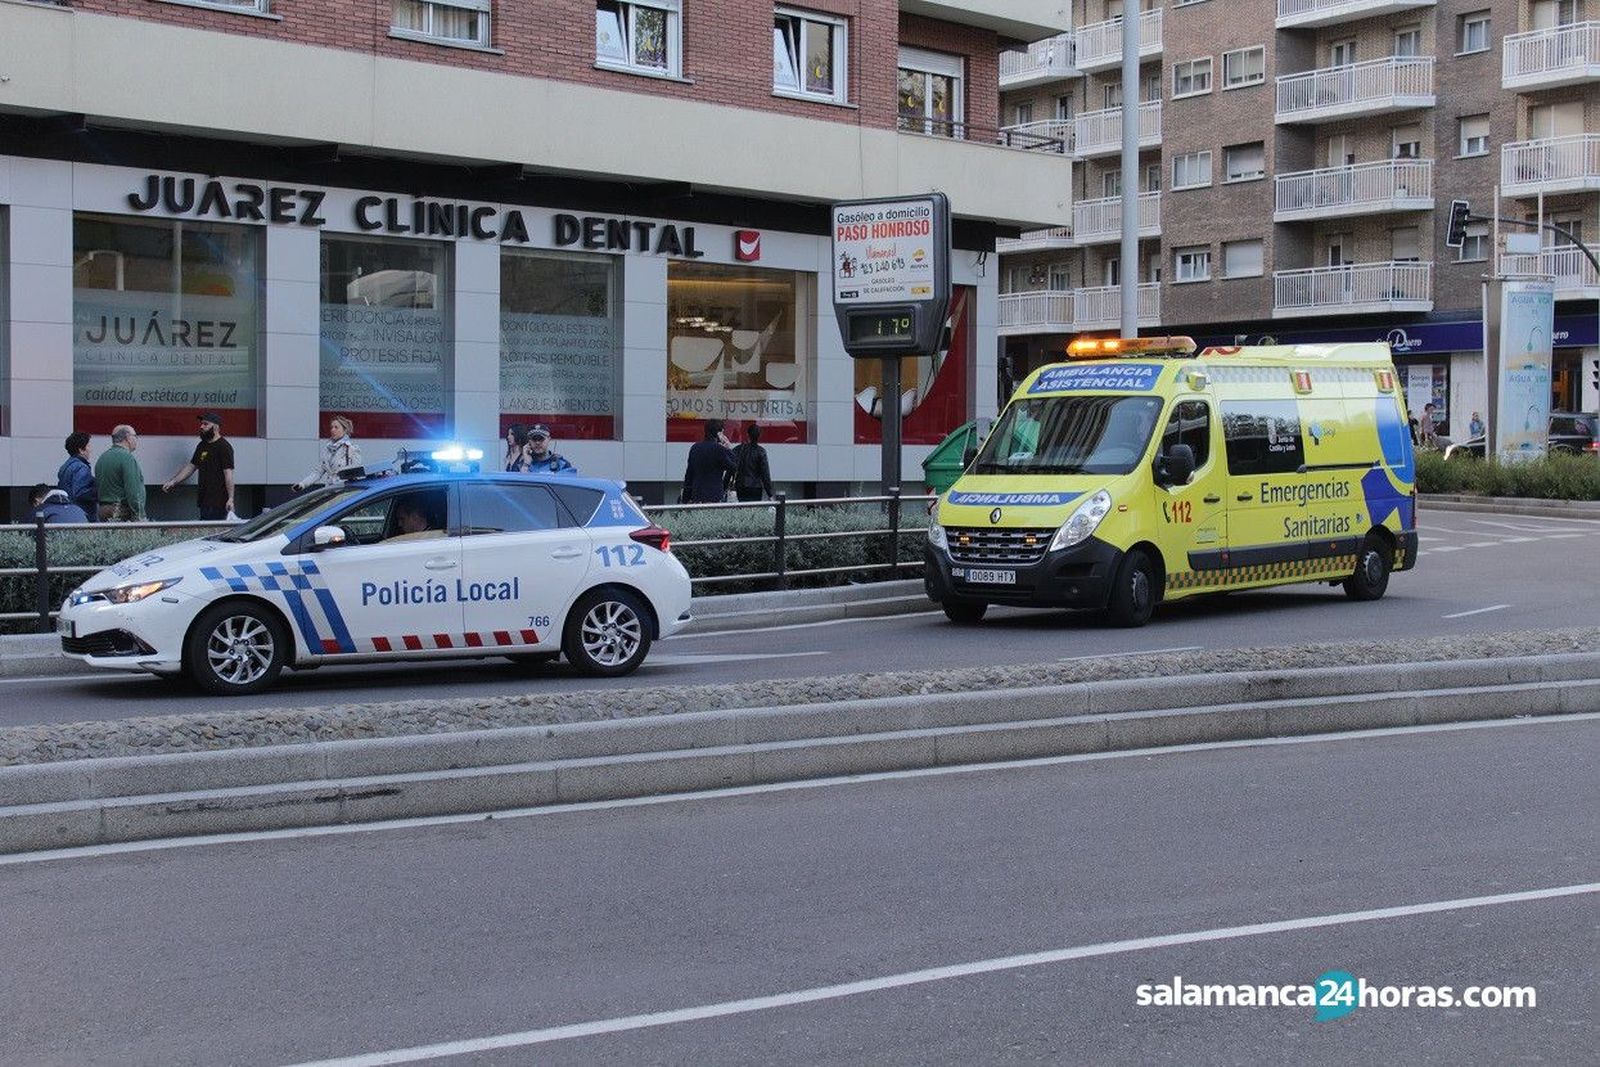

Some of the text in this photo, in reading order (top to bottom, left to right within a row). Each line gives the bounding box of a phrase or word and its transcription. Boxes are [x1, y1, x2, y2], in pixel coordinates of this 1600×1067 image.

[128, 173, 326, 226] JUÁREZ
[555, 212, 705, 259] DENTAL
[837, 206, 930, 224] Gasóleo a domicilio
[837, 219, 930, 242] PASO HONROSO
[85, 310, 238, 348] JUÁREZ
[169, 353, 237, 366] DENTAL
[411, 349, 442, 364] FIJA
[1045, 366, 1153, 379] AMBULANCIA
[1036, 377, 1146, 390] ASISTENCIAL
[85, 387, 238, 406] calidad, estética y salud
[668, 398, 714, 412] OMOS
[1260, 476, 1350, 507] Emergencias
[1171, 501, 1192, 523] 112
[1284, 512, 1350, 539] Sanitarias
[595, 543, 648, 568] 112
[997, 572, 1015, 583] HTX
[361, 577, 519, 607] Policía Local
[528, 615, 550, 628] 766
